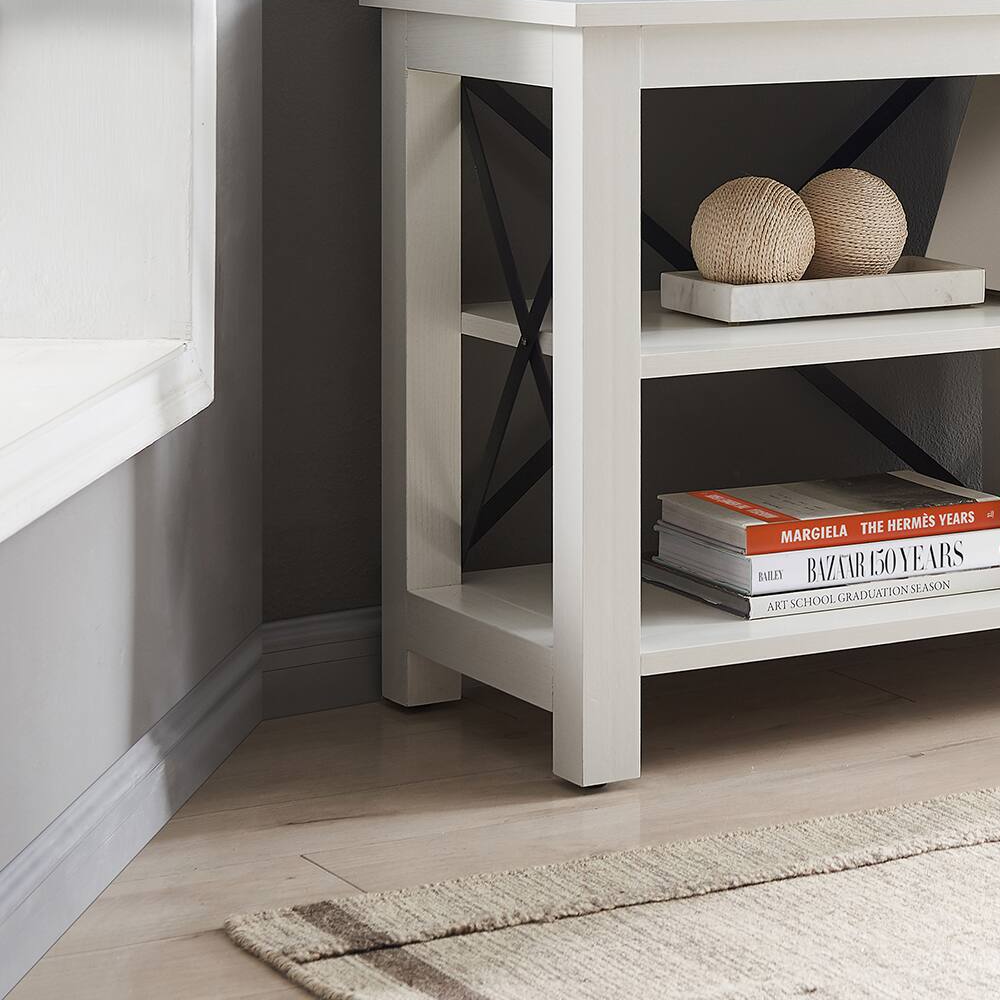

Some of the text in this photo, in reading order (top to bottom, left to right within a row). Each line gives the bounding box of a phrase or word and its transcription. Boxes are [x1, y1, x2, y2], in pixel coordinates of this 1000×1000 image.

[780, 523, 848, 544] MARGIELA
[860, 519, 884, 535] THE
[887, 511, 936, 532] HERMÈS
[938, 509, 976, 526] YEARS
[758, 568, 784, 583] BAILEY
[806, 551, 865, 584] BAZAAR
[869, 547, 897, 577] 150
[899, 539, 964, 573] YEARS
[767, 579, 951, 612] ART SCHOOL GRADUATION SEASON
